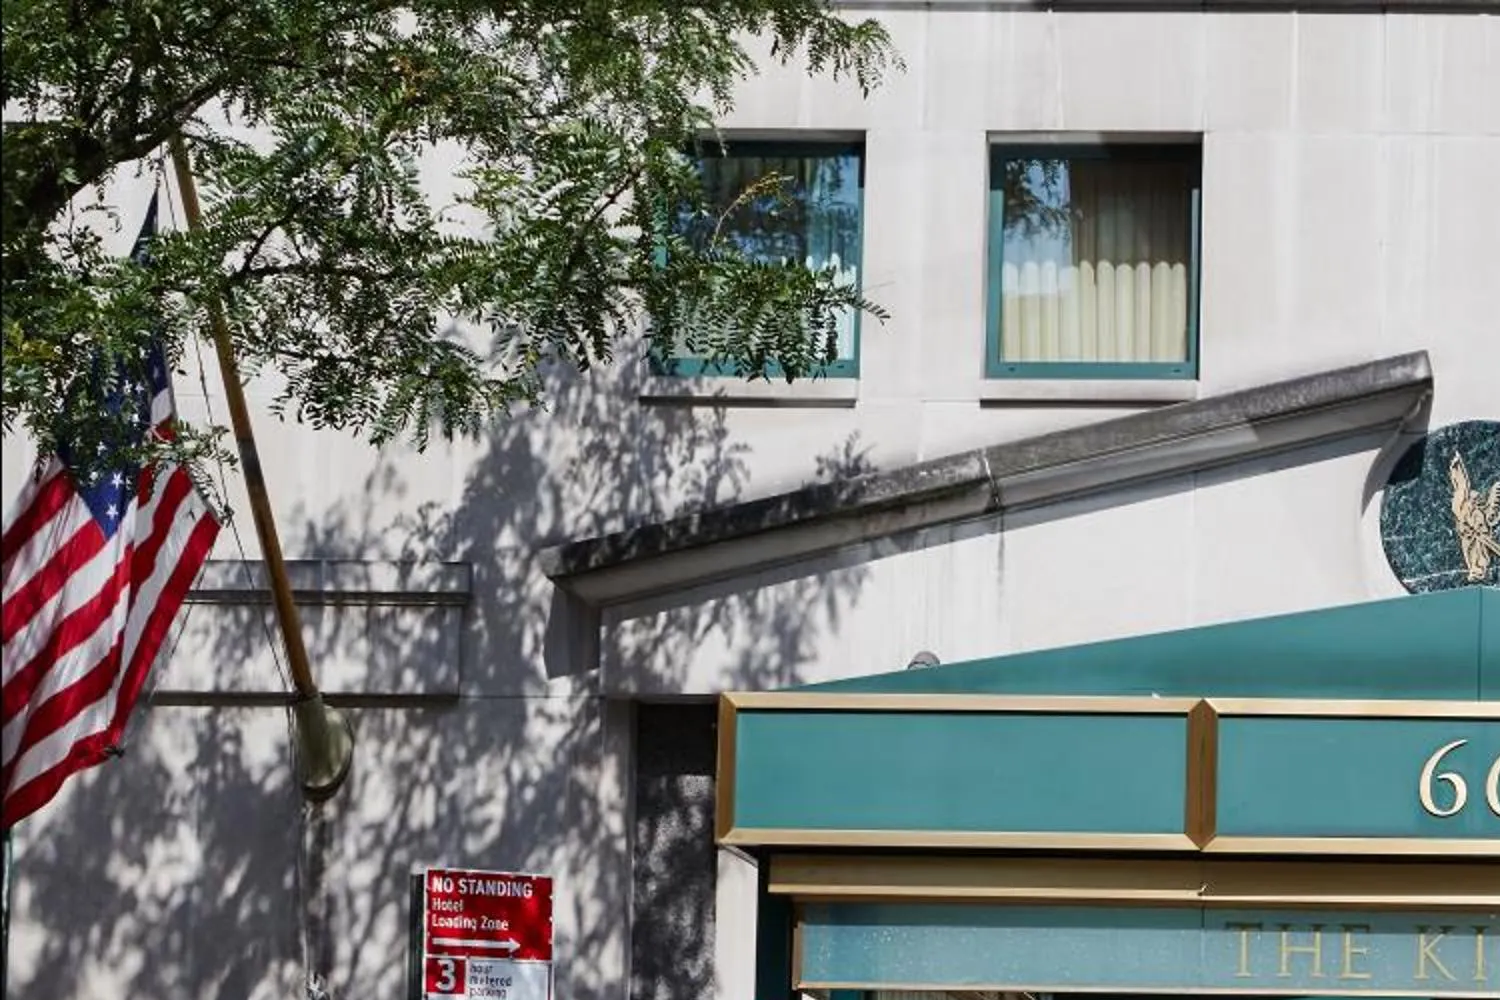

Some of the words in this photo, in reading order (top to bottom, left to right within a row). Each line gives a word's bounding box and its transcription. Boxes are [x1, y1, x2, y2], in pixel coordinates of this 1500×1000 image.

[432, 876, 454, 893] NO
[458, 877, 533, 898] STANDING
[431, 898, 464, 912] Hotel
[431, 914, 477, 932] Loading
[480, 915, 509, 931] Zone
[1225, 922, 1373, 981] THE
[435, 958, 456, 991] 3
[469, 987, 507, 1000] parking
